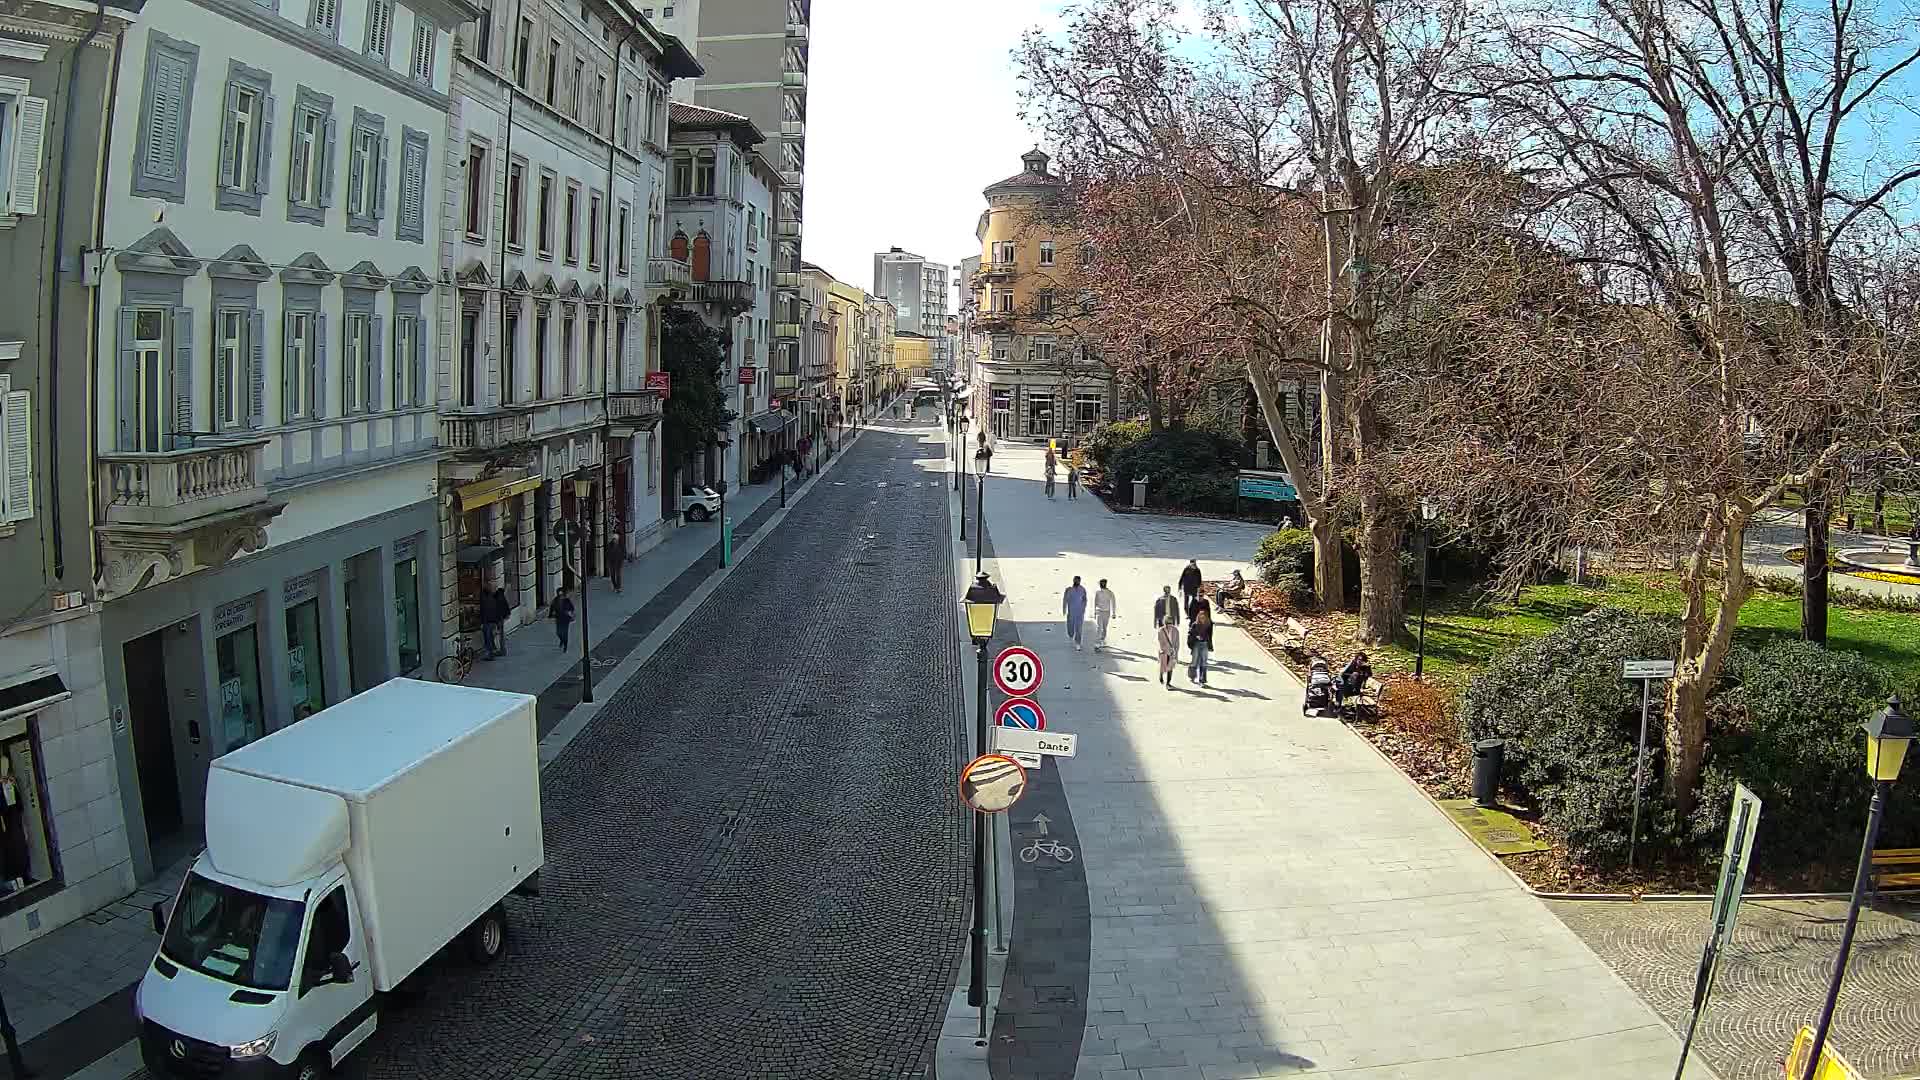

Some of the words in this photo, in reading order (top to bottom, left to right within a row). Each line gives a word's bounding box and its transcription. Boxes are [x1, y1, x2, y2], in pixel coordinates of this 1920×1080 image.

[1005, 660, 1033, 683] 30
[222, 679, 240, 703] 130
[1038, 740, 1070, 752] Dante
